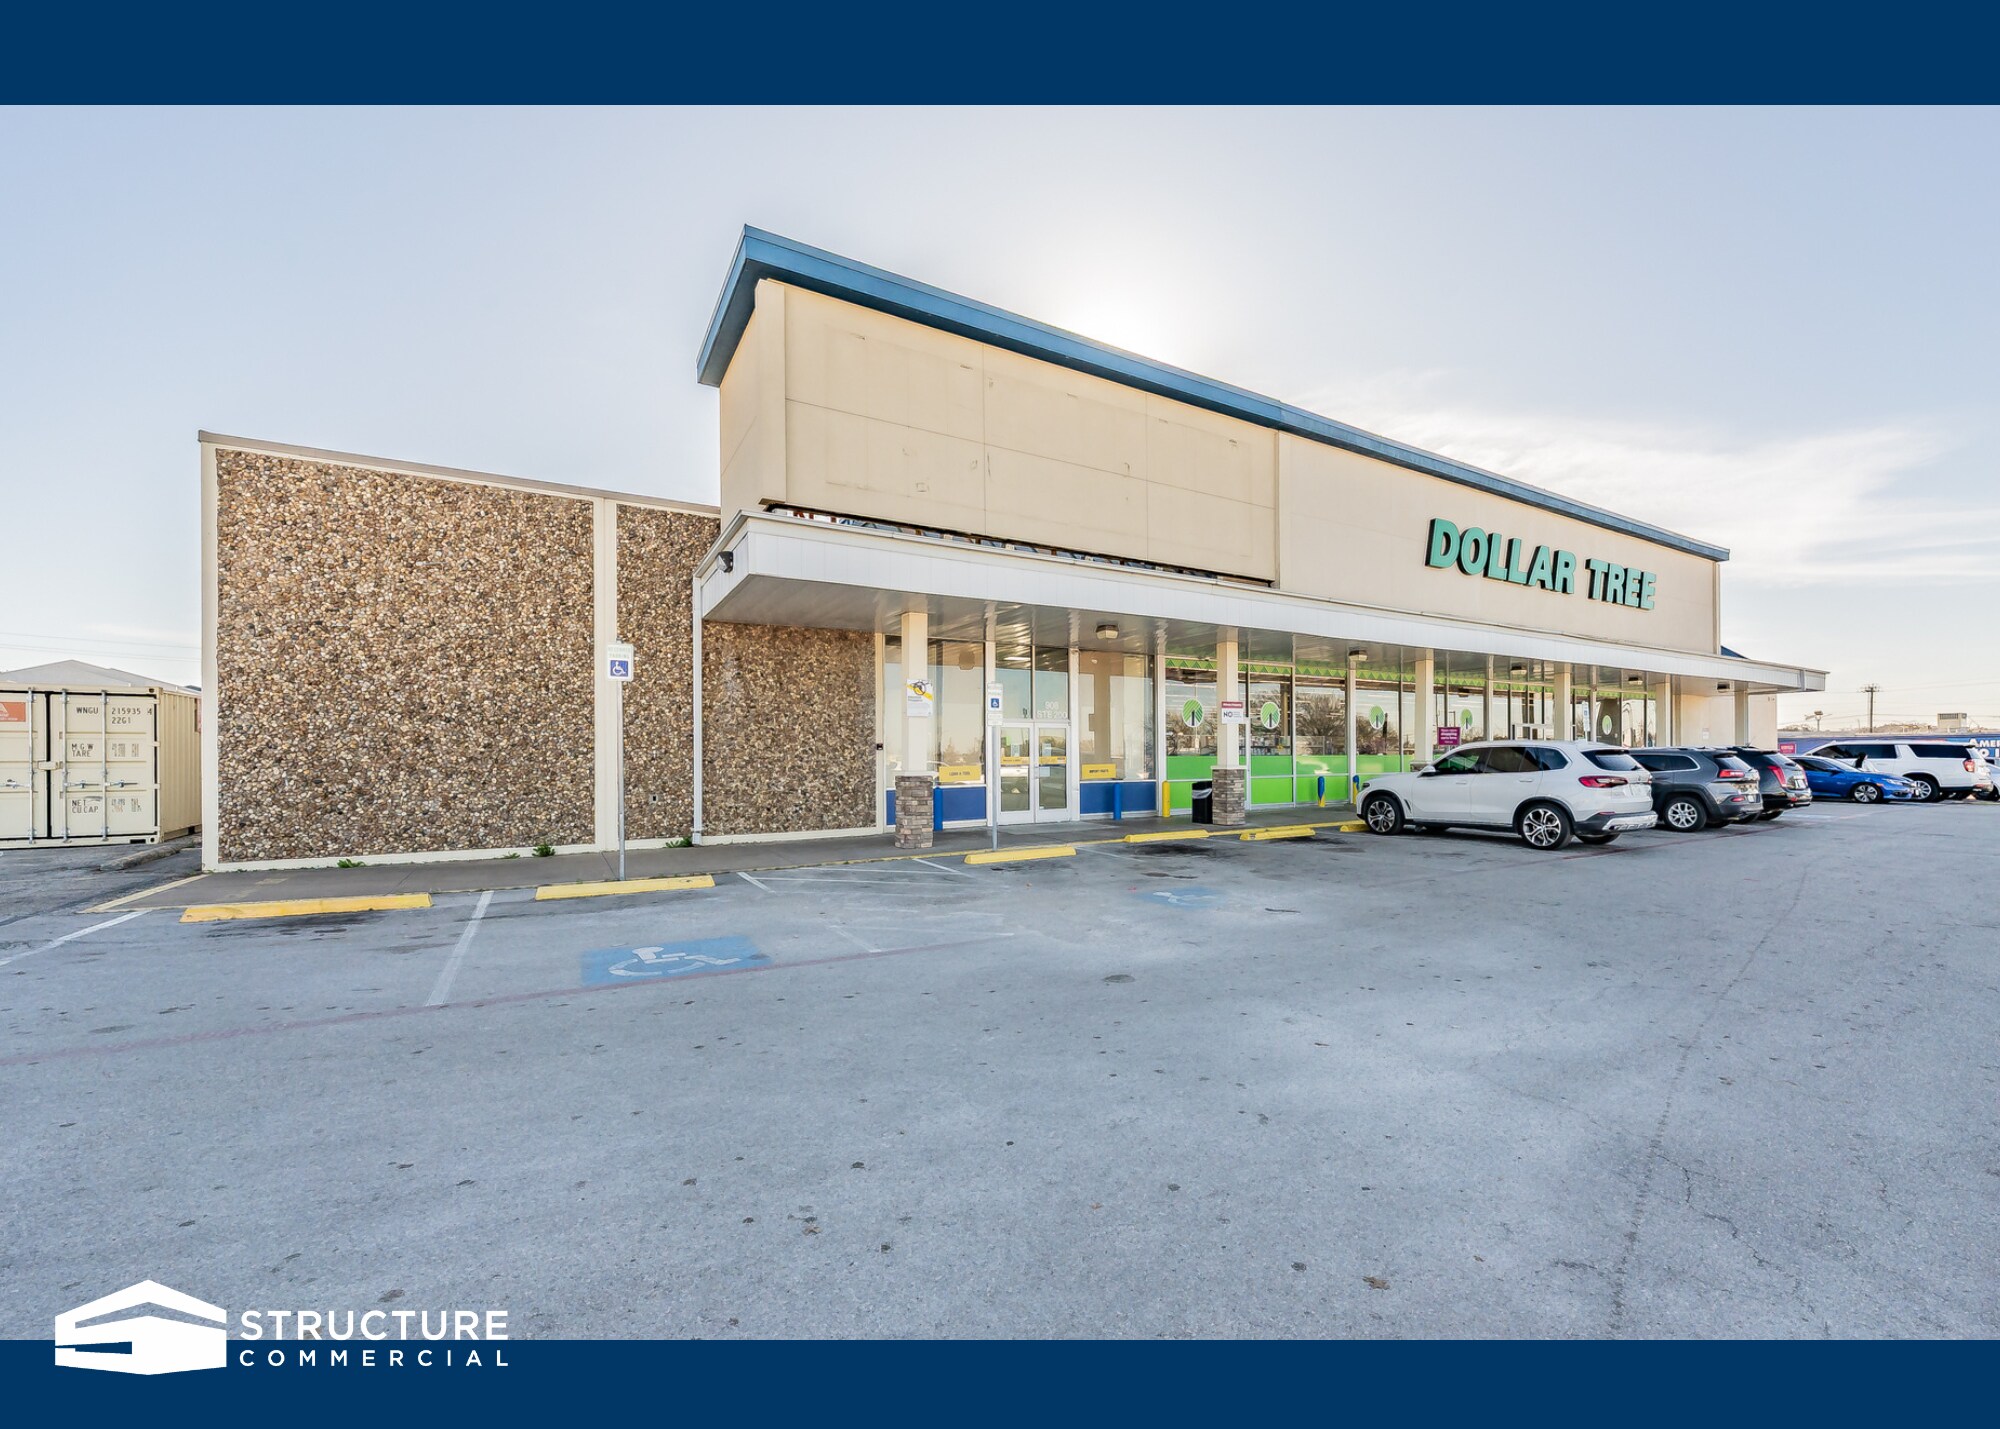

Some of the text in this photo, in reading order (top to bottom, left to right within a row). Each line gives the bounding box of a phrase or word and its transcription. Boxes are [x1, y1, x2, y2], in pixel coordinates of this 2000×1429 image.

[1425, 518, 1657, 610] DOLLAR TREE
[76, 707, 99, 715] WNGU
[111, 707, 141, 715] 215935
[72, 749, 92, 757] TARE
